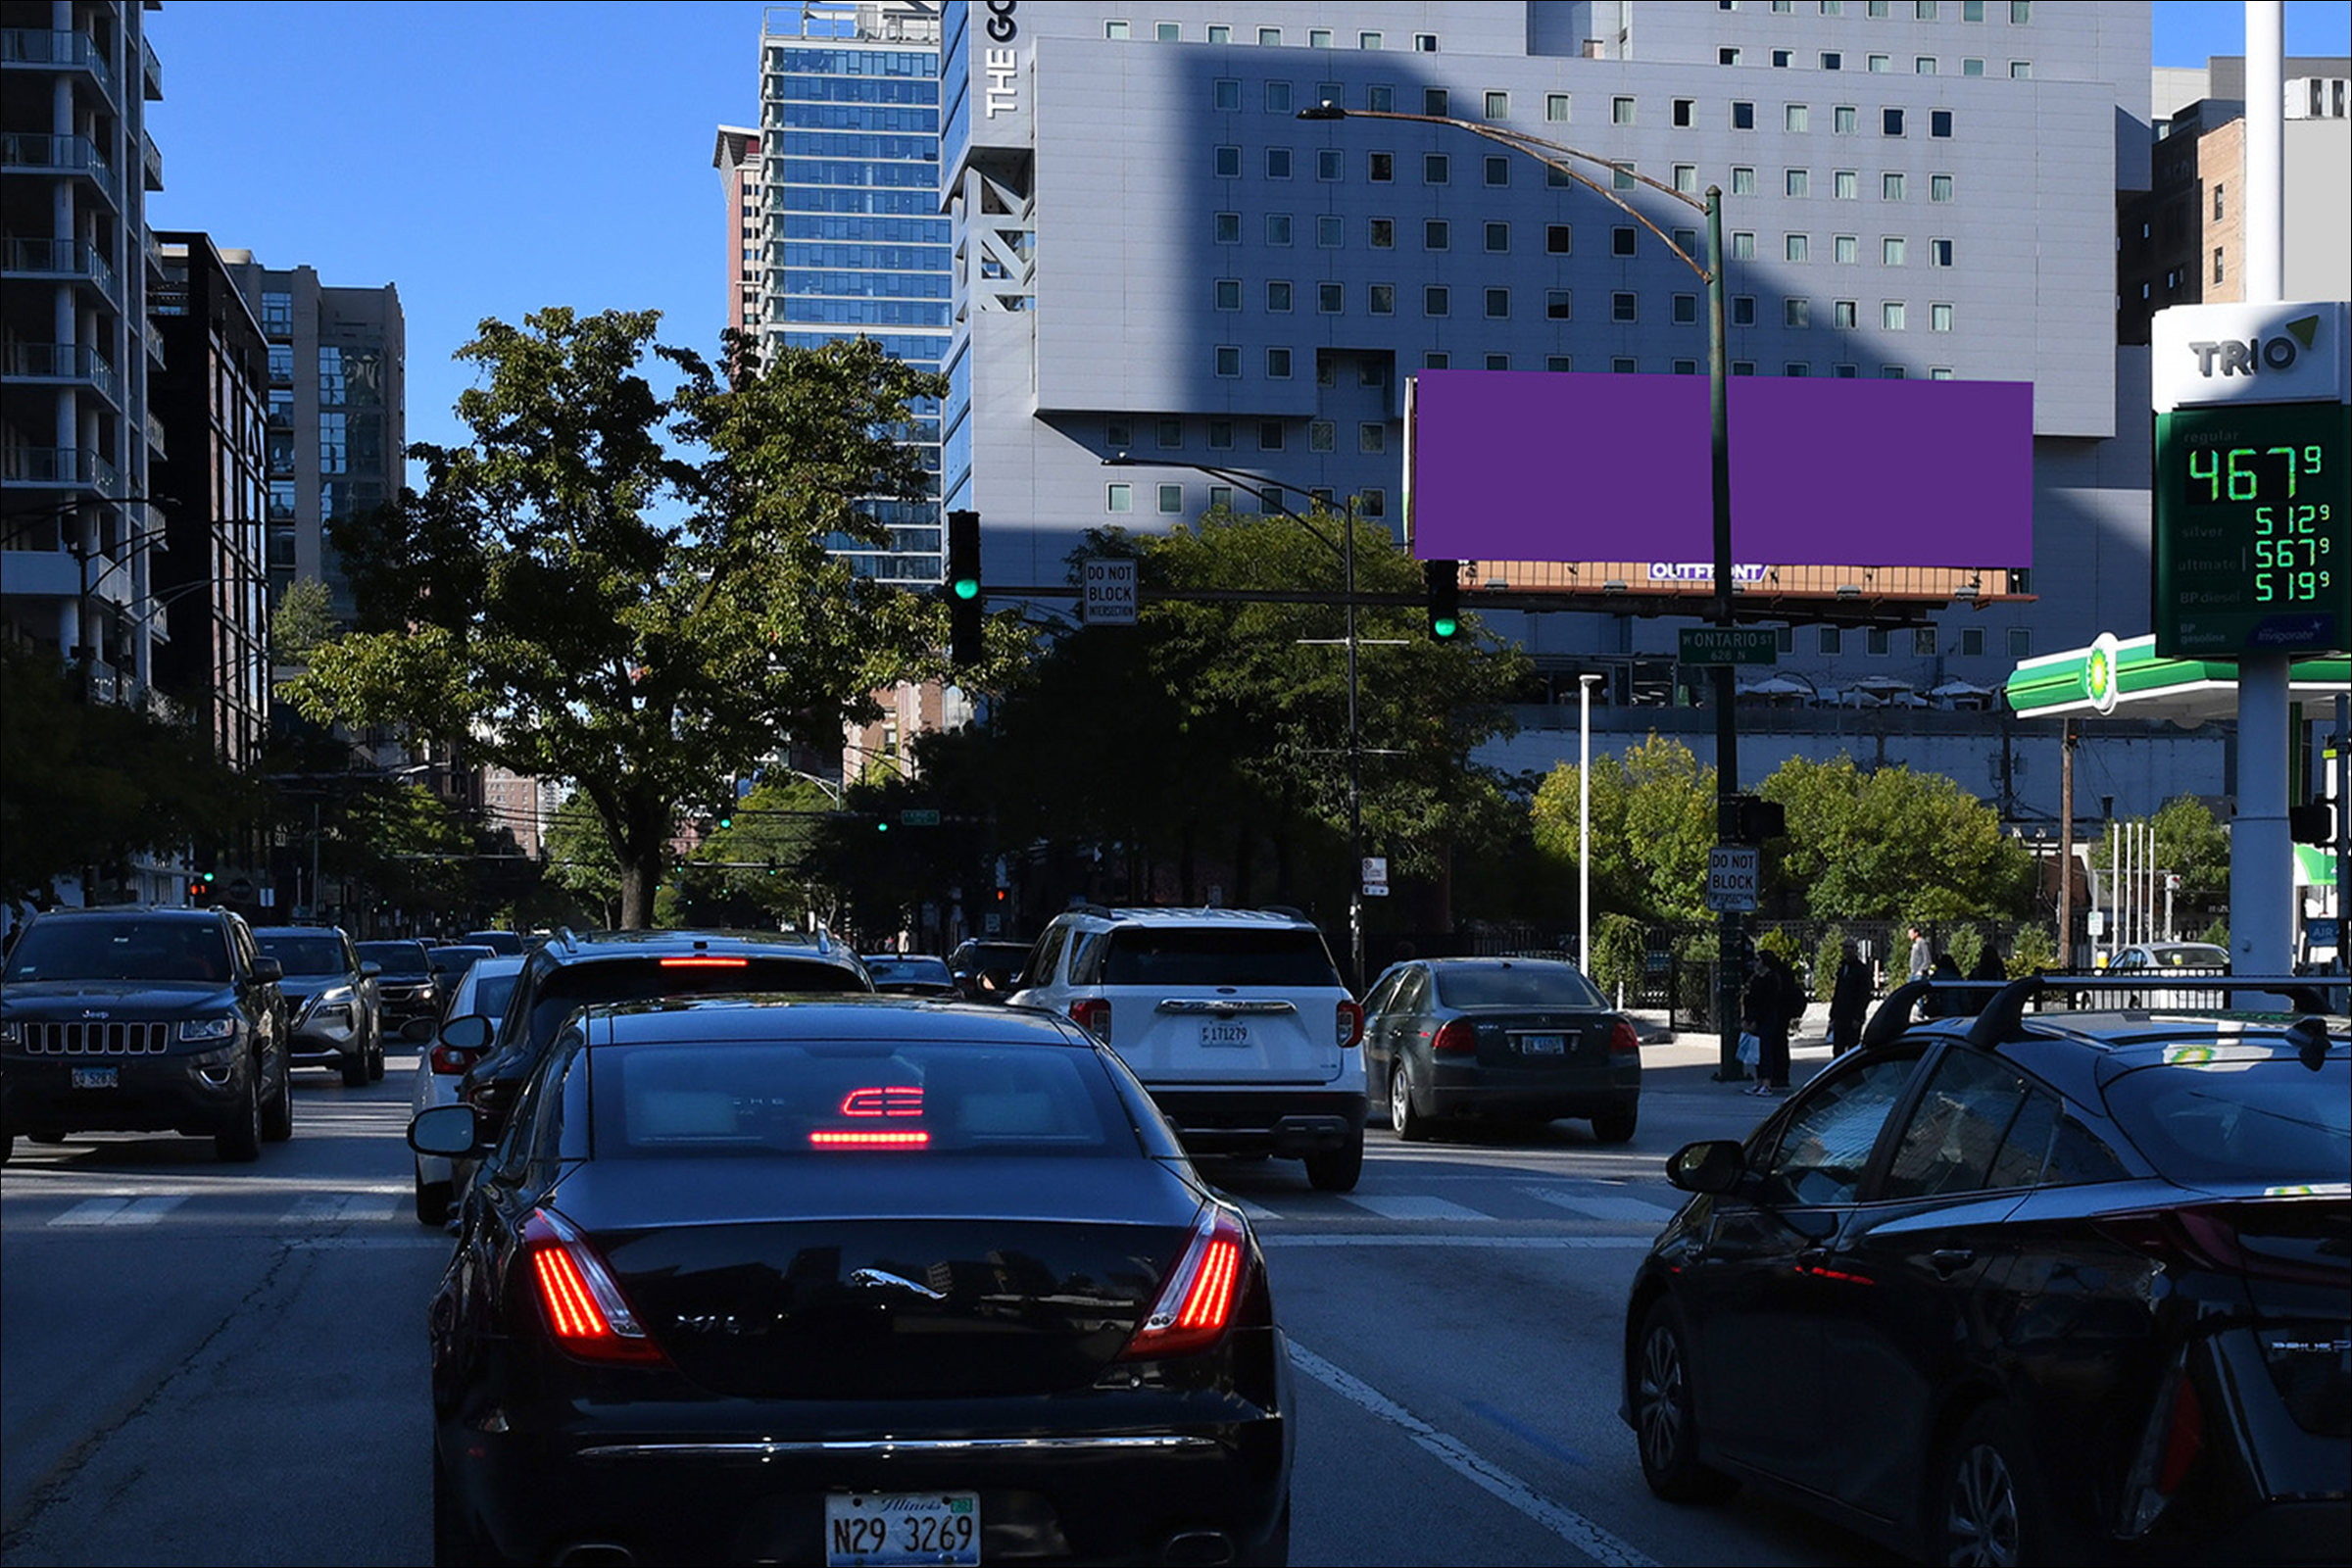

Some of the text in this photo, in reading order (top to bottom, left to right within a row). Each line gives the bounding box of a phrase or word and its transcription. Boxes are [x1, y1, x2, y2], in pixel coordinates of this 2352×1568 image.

[986, 49, 1016, 119] THE
[2188, 336, 2296, 377] TRIO
[2183, 429, 2239, 444] regular
[1088, 566, 1132, 580] DO NOT
[1652, 563, 1763, 579] OUTFNT
[1089, 587, 1132, 602] BLOCK
[2180, 591, 2198, 604] BP
[1089, 605, 1133, 617] INTERSECTION
[1683, 633, 1772, 648] W ONTARIO ST
[1710, 651, 1746, 661] 628 N
[1712, 855, 1754, 868] DO NOT
[1712, 874, 1753, 889] BLOCK
[2312, 926, 2333, 938] AIR
[1211, 1026, 1248, 1041] 171279
[881, 1496, 941, 1512] Illinois
[834, 1515, 972, 1554] N29 3269
